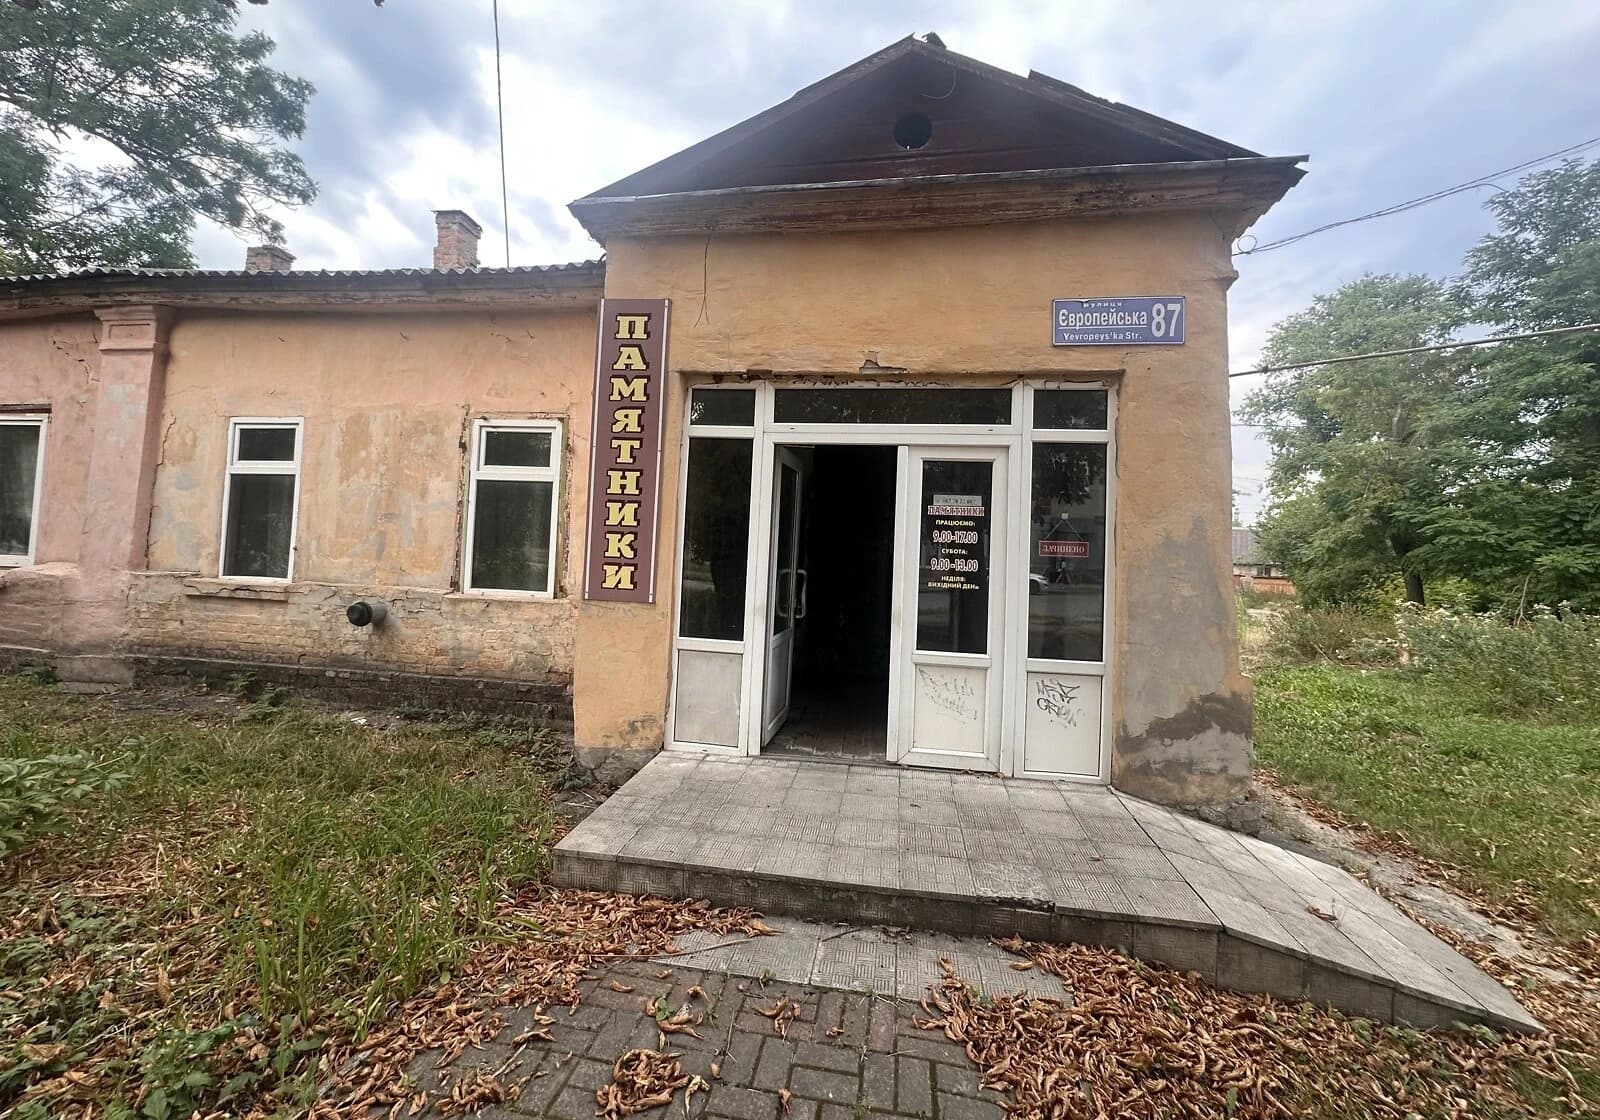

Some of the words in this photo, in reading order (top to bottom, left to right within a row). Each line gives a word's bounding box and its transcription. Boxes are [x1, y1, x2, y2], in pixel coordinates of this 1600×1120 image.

[1059, 308, 1147, 329] Європейська
[1151, 303, 1181, 337] 87
[1063, 332, 1124, 341] Yevropeys'ka
[1125, 331, 1142, 340] Str.
[602, 314, 649, 590] ПАМЯТНИКИ
[932, 530, 978, 544] 9.00-17.00
[1042, 544, 1085, 553] ЗАЧИНЕНО
